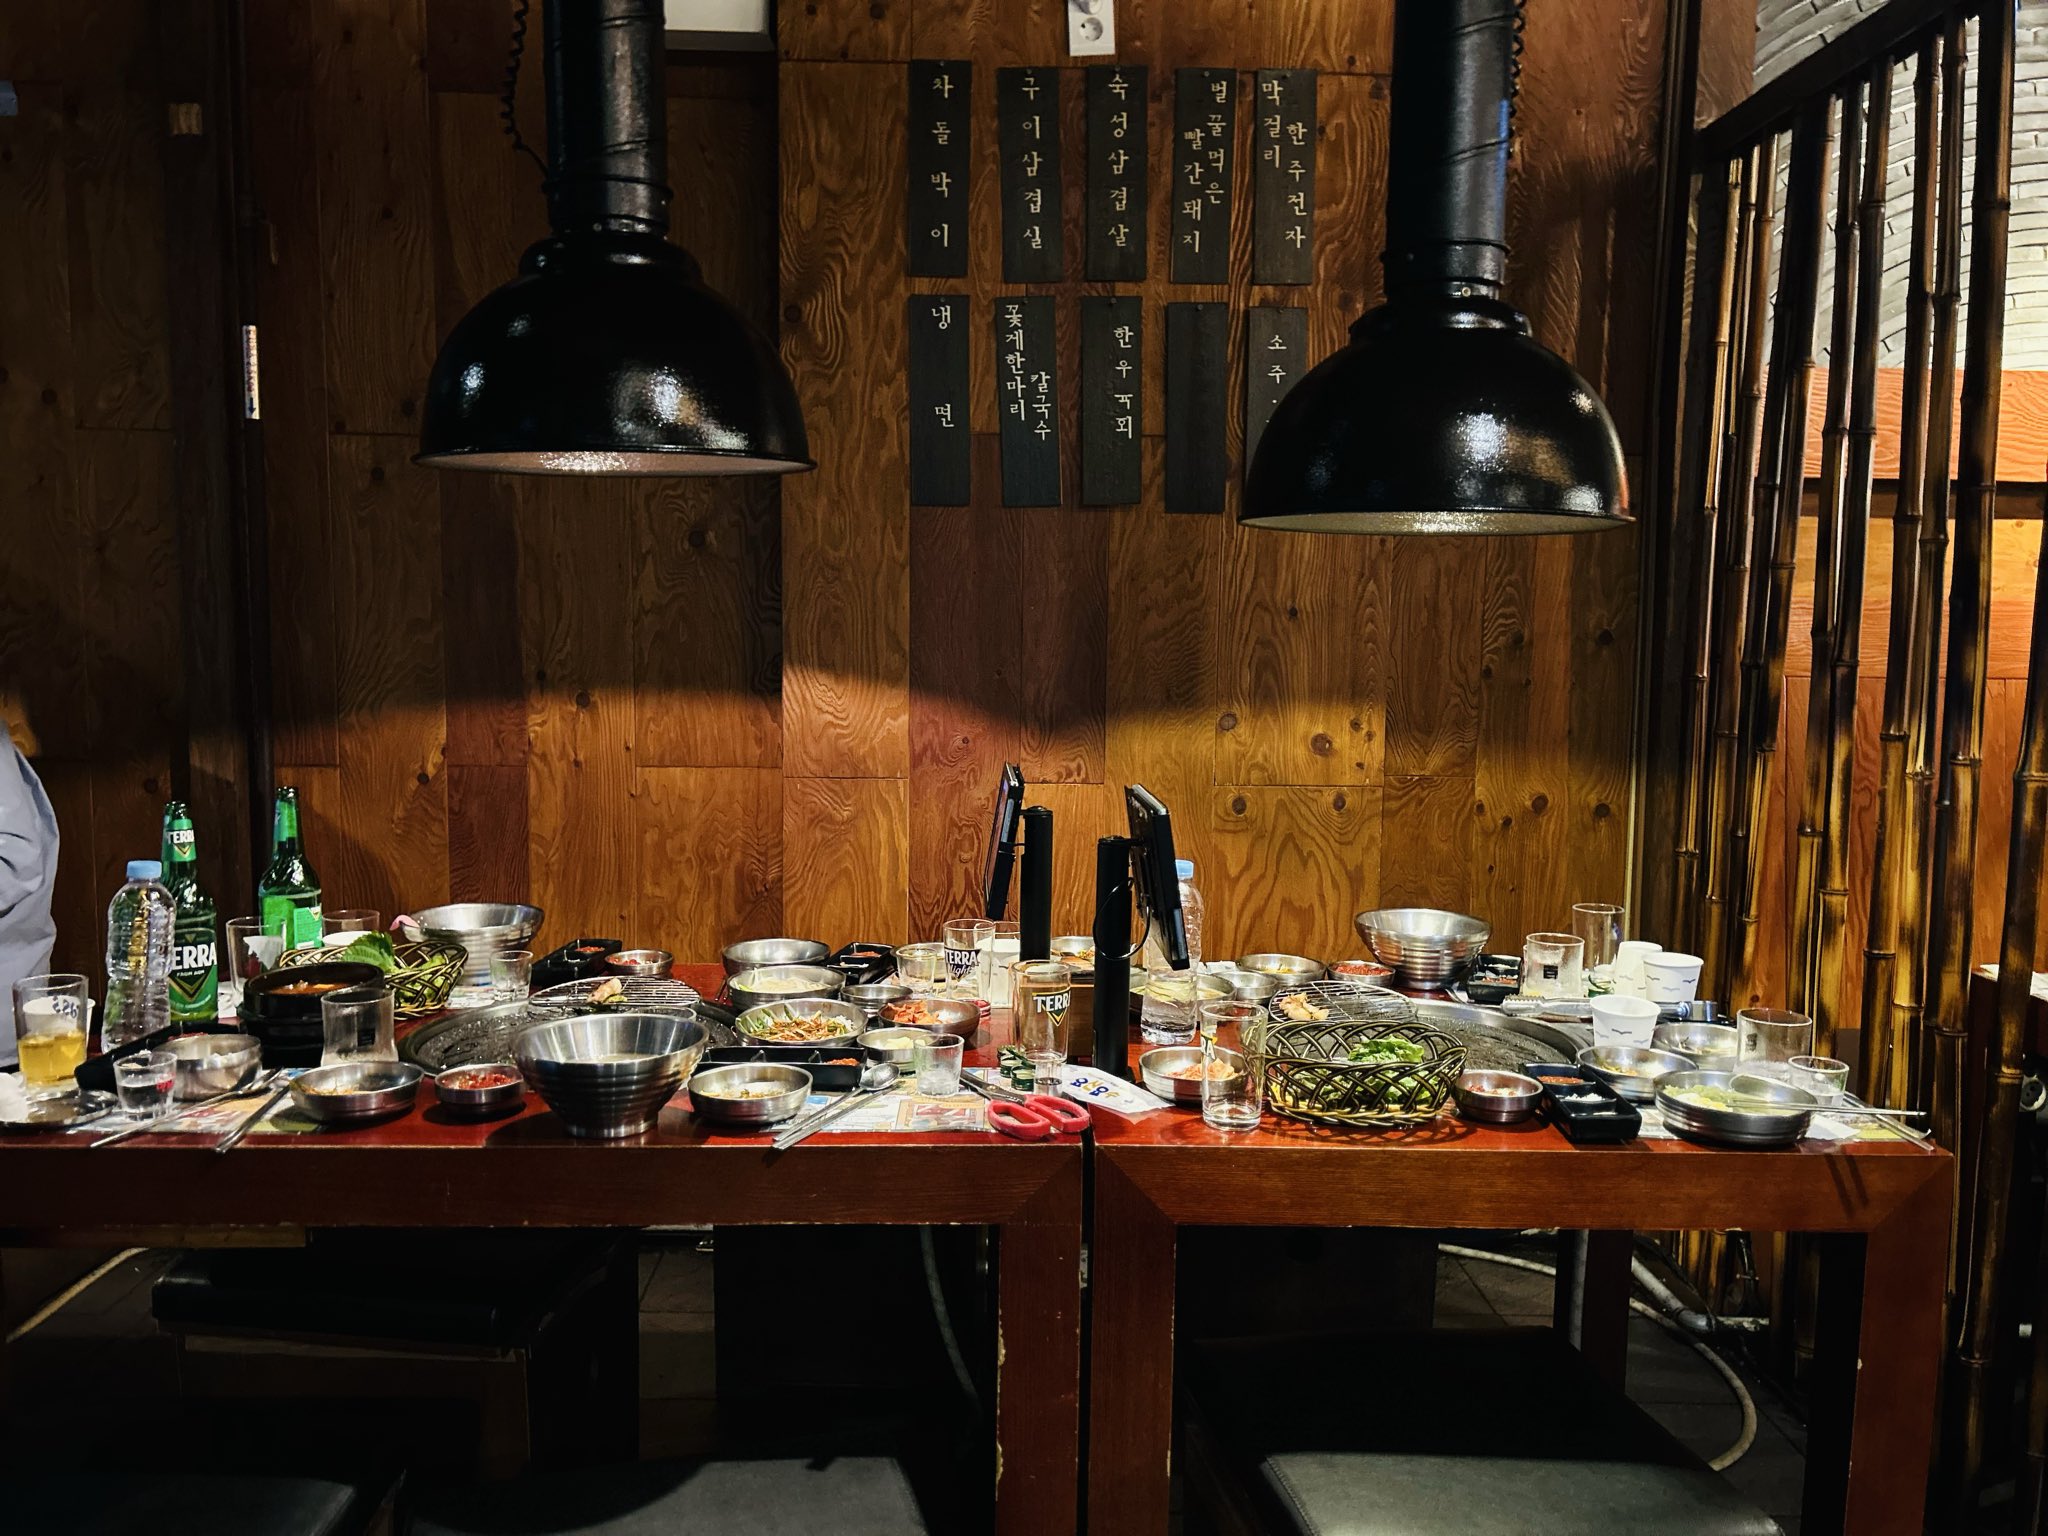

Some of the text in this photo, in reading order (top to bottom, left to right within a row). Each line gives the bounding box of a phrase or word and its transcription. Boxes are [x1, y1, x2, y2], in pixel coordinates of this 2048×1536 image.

[931, 75, 954, 248] 차돌박이
[1108, 74, 1130, 247] 숙성삼겹살
[1205, 81, 1228, 204] 벌꿀먹은
[1261, 79, 1284, 169] 막걸리
[1285, 122, 1308, 248] 한주전자
[1182, 128, 1205, 253] 빨간돼지
[931, 305, 955, 428] 냉면
[1004, 304, 1027, 421] 꽃게한마리
[1030, 371, 1052, 441] 칼국수
[172, 942, 217, 970] ERRA
[945, 949, 978, 966] TERRA
